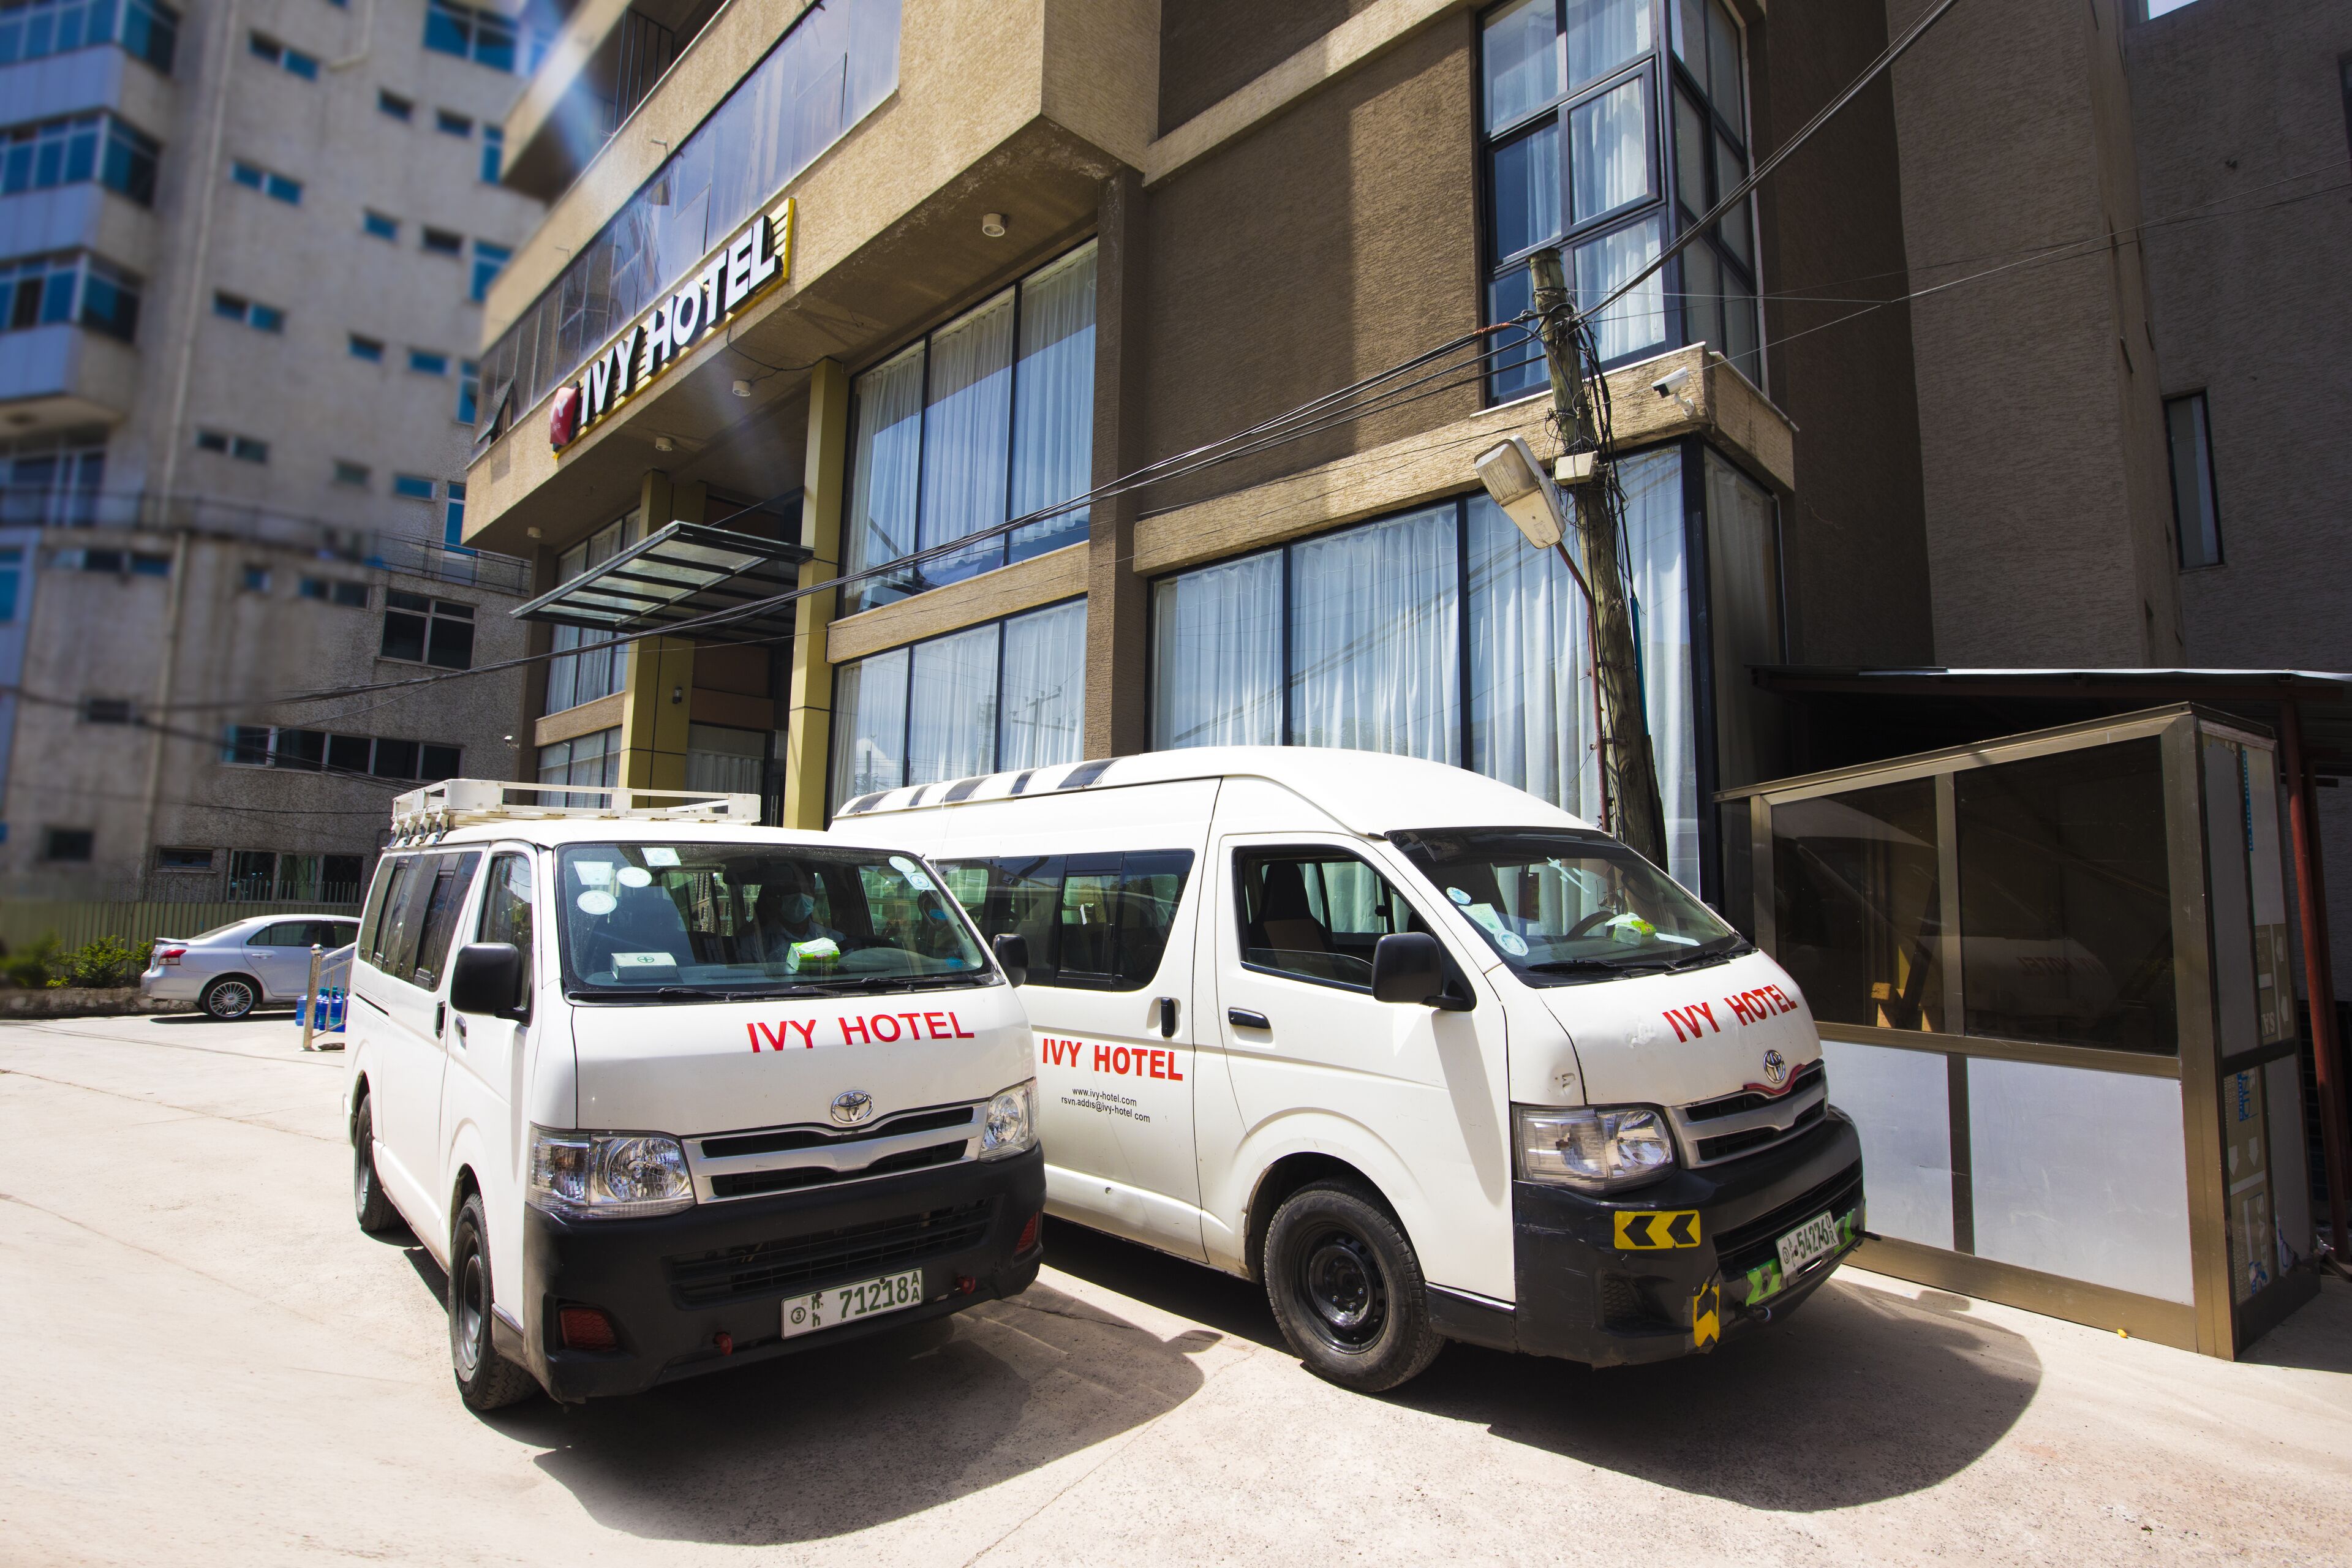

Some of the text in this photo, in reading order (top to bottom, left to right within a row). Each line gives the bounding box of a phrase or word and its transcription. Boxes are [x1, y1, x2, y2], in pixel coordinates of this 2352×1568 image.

[580, 214, 779, 427] IVY HOTEL
[746, 1012, 975, 1053] IVY HOTEL
[1662, 984, 1798, 1043] IVY HOTEL
[1042, 1038, 1183, 1081] IVY HOTEL
[1061, 1096, 1150, 1123] rsvn.addis@ivy-hotelcom
[1072, 1088, 1137, 1107] www.ivy-hotel.com
[1796, 1219, 1830, 1259] 54276
[840, 1276, 909, 1319] 71218
